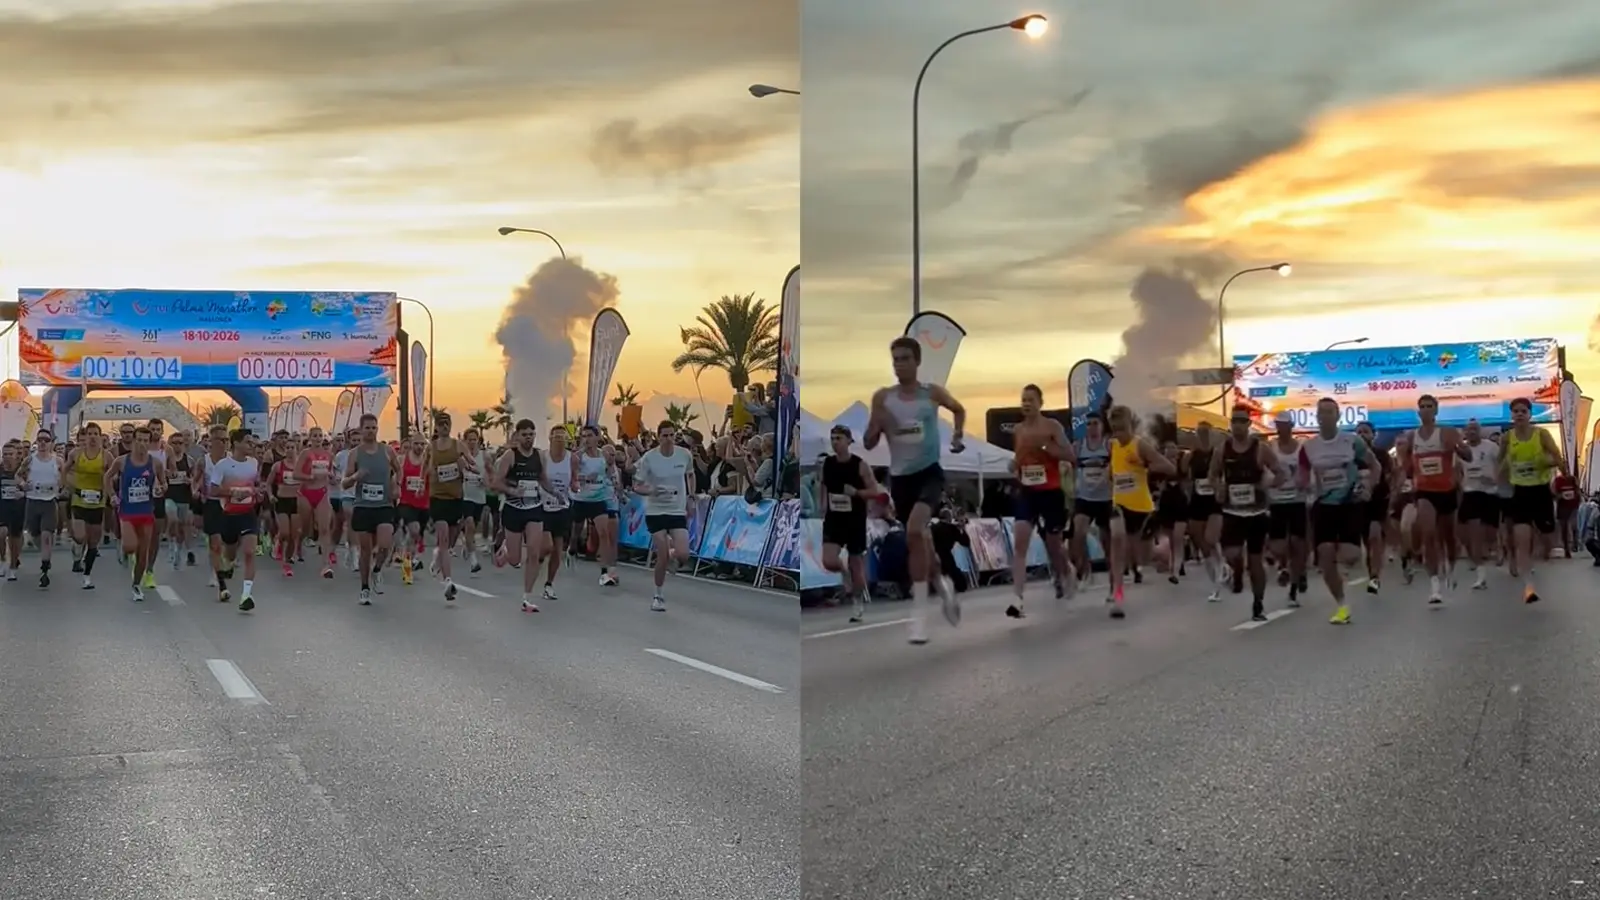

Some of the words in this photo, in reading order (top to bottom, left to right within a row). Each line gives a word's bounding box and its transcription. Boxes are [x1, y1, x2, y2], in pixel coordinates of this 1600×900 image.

[207, 299, 259, 313] Marathon
[311, 331, 332, 340] FNG
[84, 356, 180, 378] 00:10:04
[240, 358, 333, 379] 00:00:04
[116, 404, 142, 414] FNG
[1288, 405, 1367, 428] 00::05
